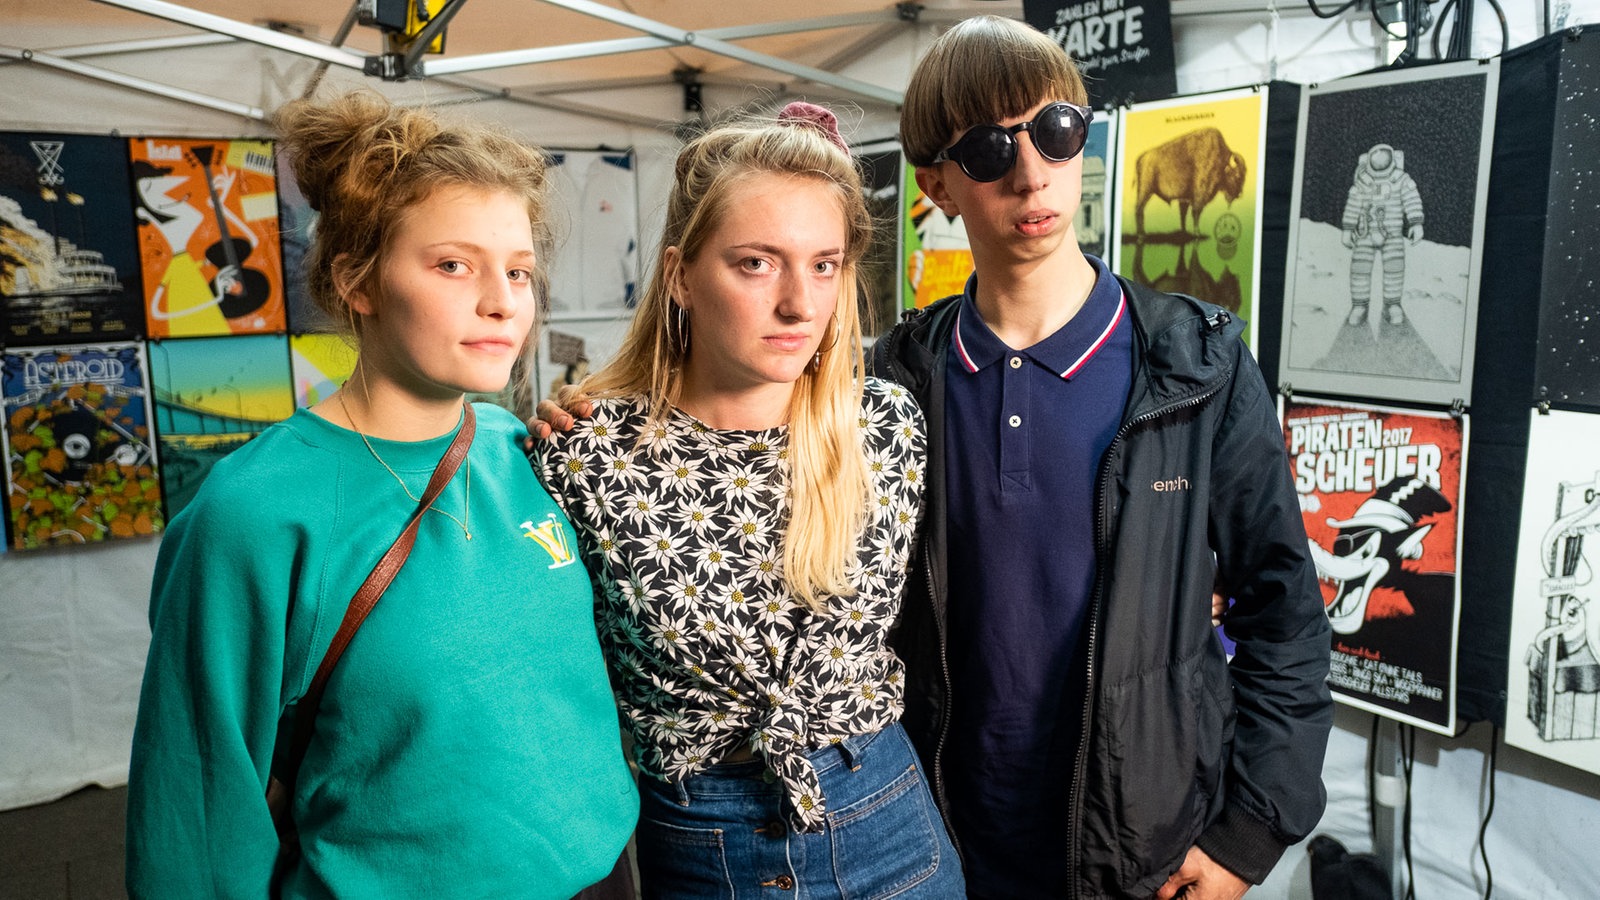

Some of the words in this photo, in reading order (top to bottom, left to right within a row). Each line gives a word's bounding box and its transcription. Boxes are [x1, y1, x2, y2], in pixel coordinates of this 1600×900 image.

[1055, 1, 1100, 25] ZAHLEN
[25, 359, 125, 386] ASTEROID
[1290, 419, 1382, 455] PIRATEN
[1383, 427, 1412, 447] 2017
[1295, 443, 1442, 494] SCHEUER
